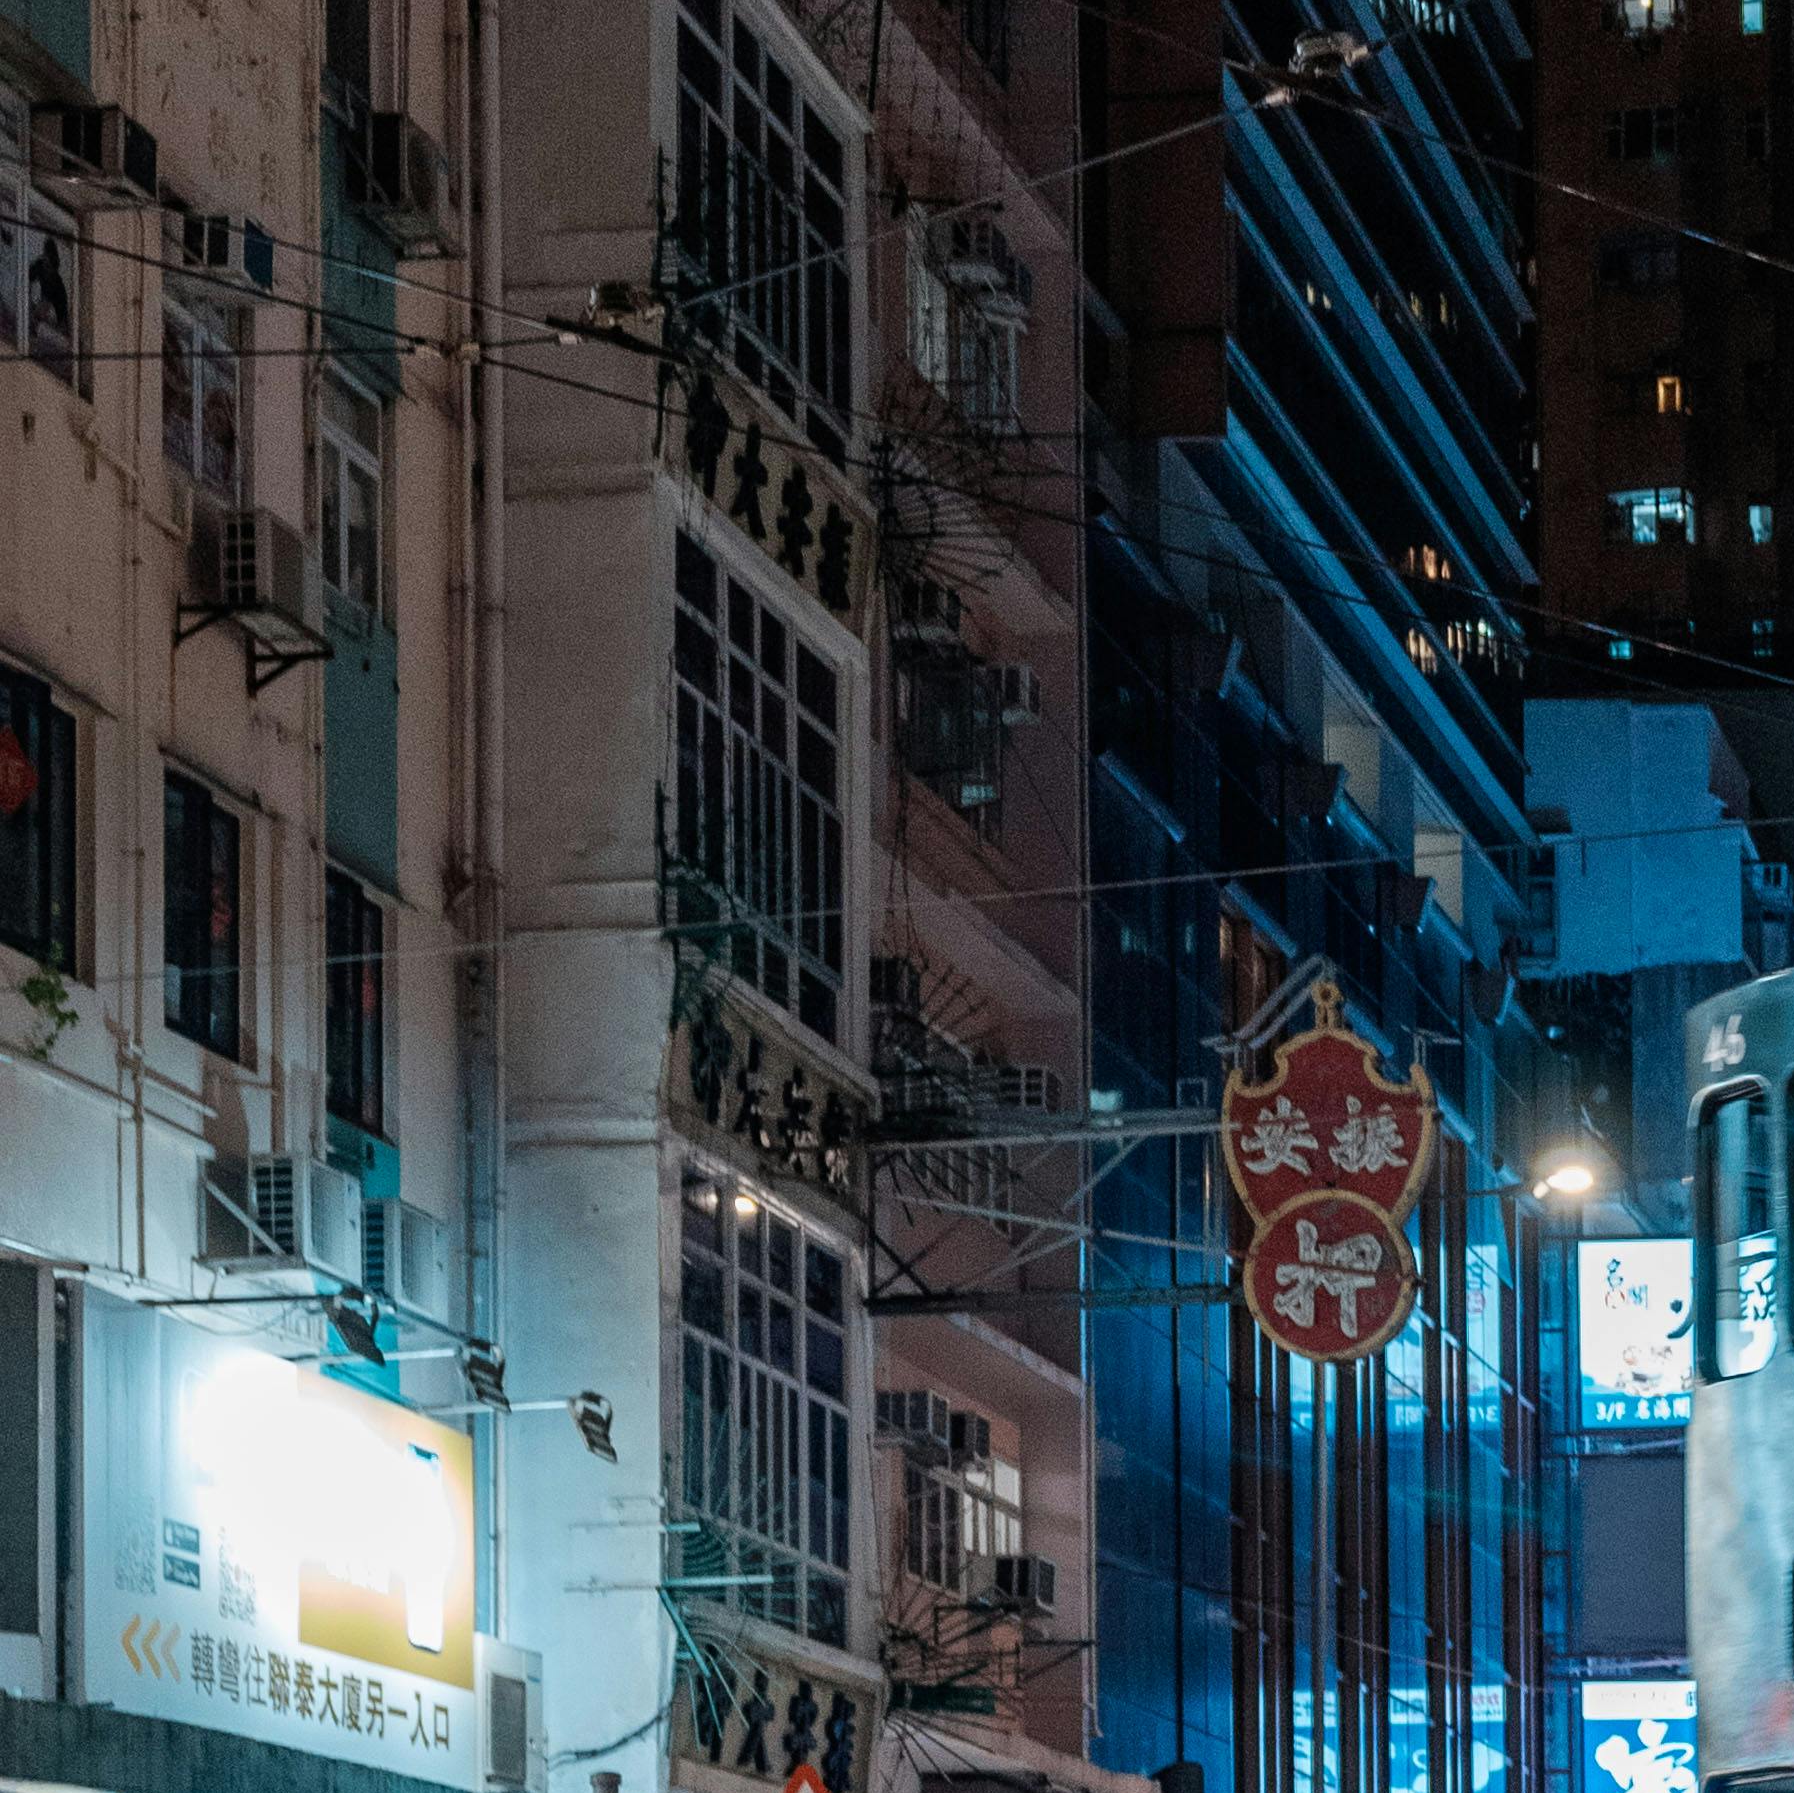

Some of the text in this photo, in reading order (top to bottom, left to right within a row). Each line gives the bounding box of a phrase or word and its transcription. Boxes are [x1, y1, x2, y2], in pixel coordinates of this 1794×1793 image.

[1702, 1015, 1746, 1070] 46
[1273, 1217, 1383, 1339] 押
[190, 1627, 451, 1752] 轉彎往聯泰大廈另一入口
